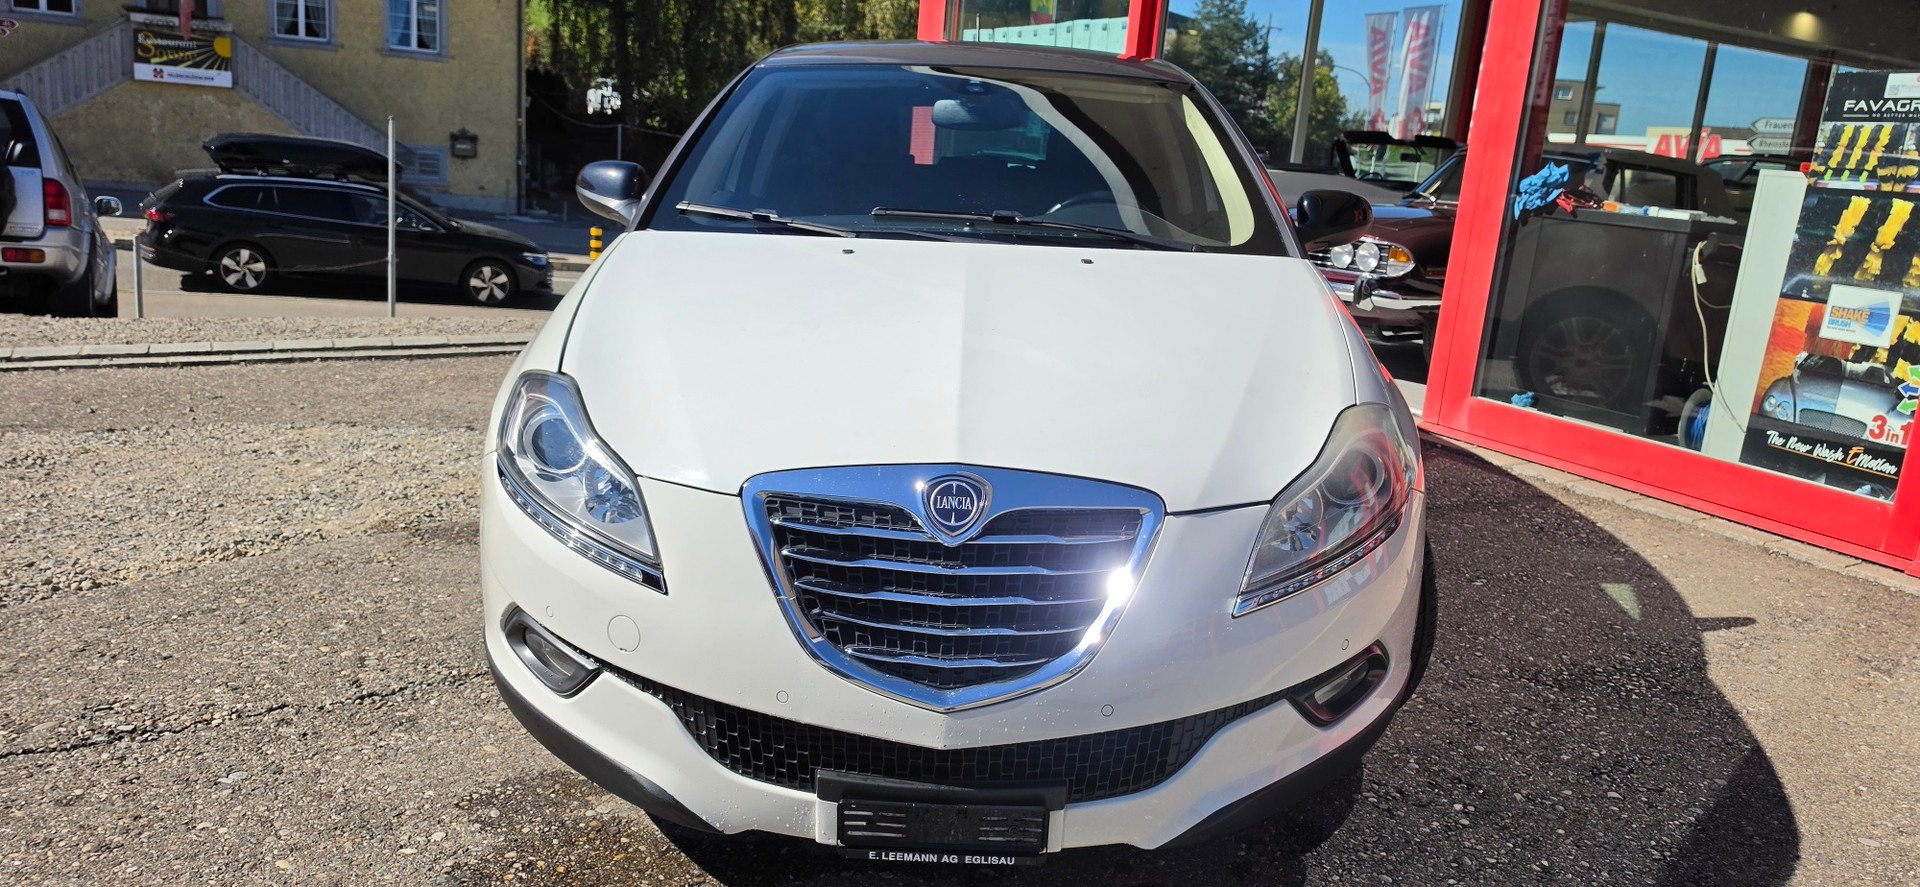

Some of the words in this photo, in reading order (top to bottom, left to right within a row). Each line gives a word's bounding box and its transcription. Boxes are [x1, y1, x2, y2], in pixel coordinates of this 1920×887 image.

[1830, 307, 1870, 325] SHAKE
[1766, 430, 1786, 446] The
[1786, 436, 1812, 453] New
[1813, 443, 1845, 462] Wash
[936, 495, 972, 510] LANCIA
[868, 851, 879, 860] E.
[881, 852, 938, 863] LEEMANN
[941, 855, 958, 864] AG
[965, 856, 1016, 866] EGLISAU
